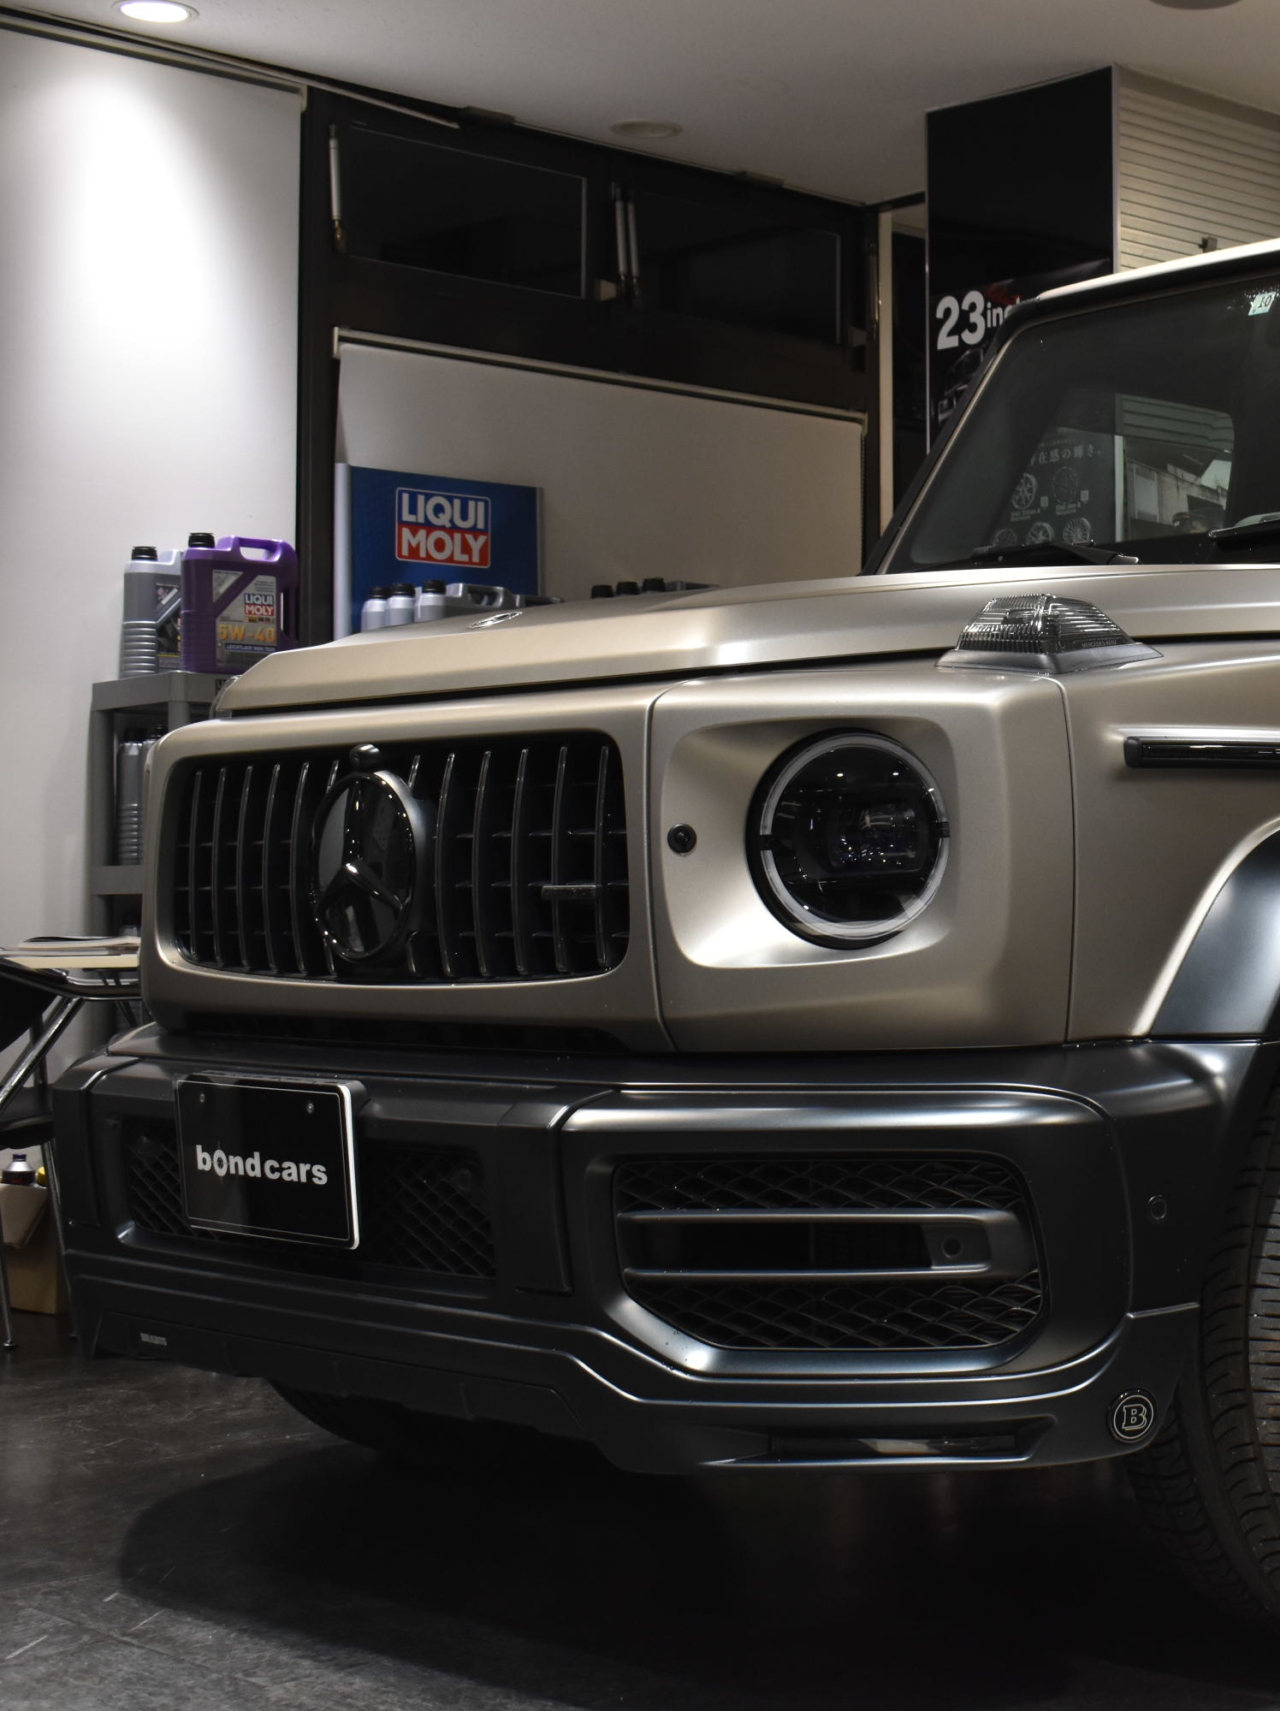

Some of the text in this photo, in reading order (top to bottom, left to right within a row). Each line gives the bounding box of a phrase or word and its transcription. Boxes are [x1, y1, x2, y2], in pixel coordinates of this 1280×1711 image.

[402, 492, 485, 529] LIQUI
[401, 527, 487, 564] MOLY
[244, 594, 274, 605] LIQUI
[245, 604, 274, 616] MOLY
[218, 623, 276, 643] 5W-40
